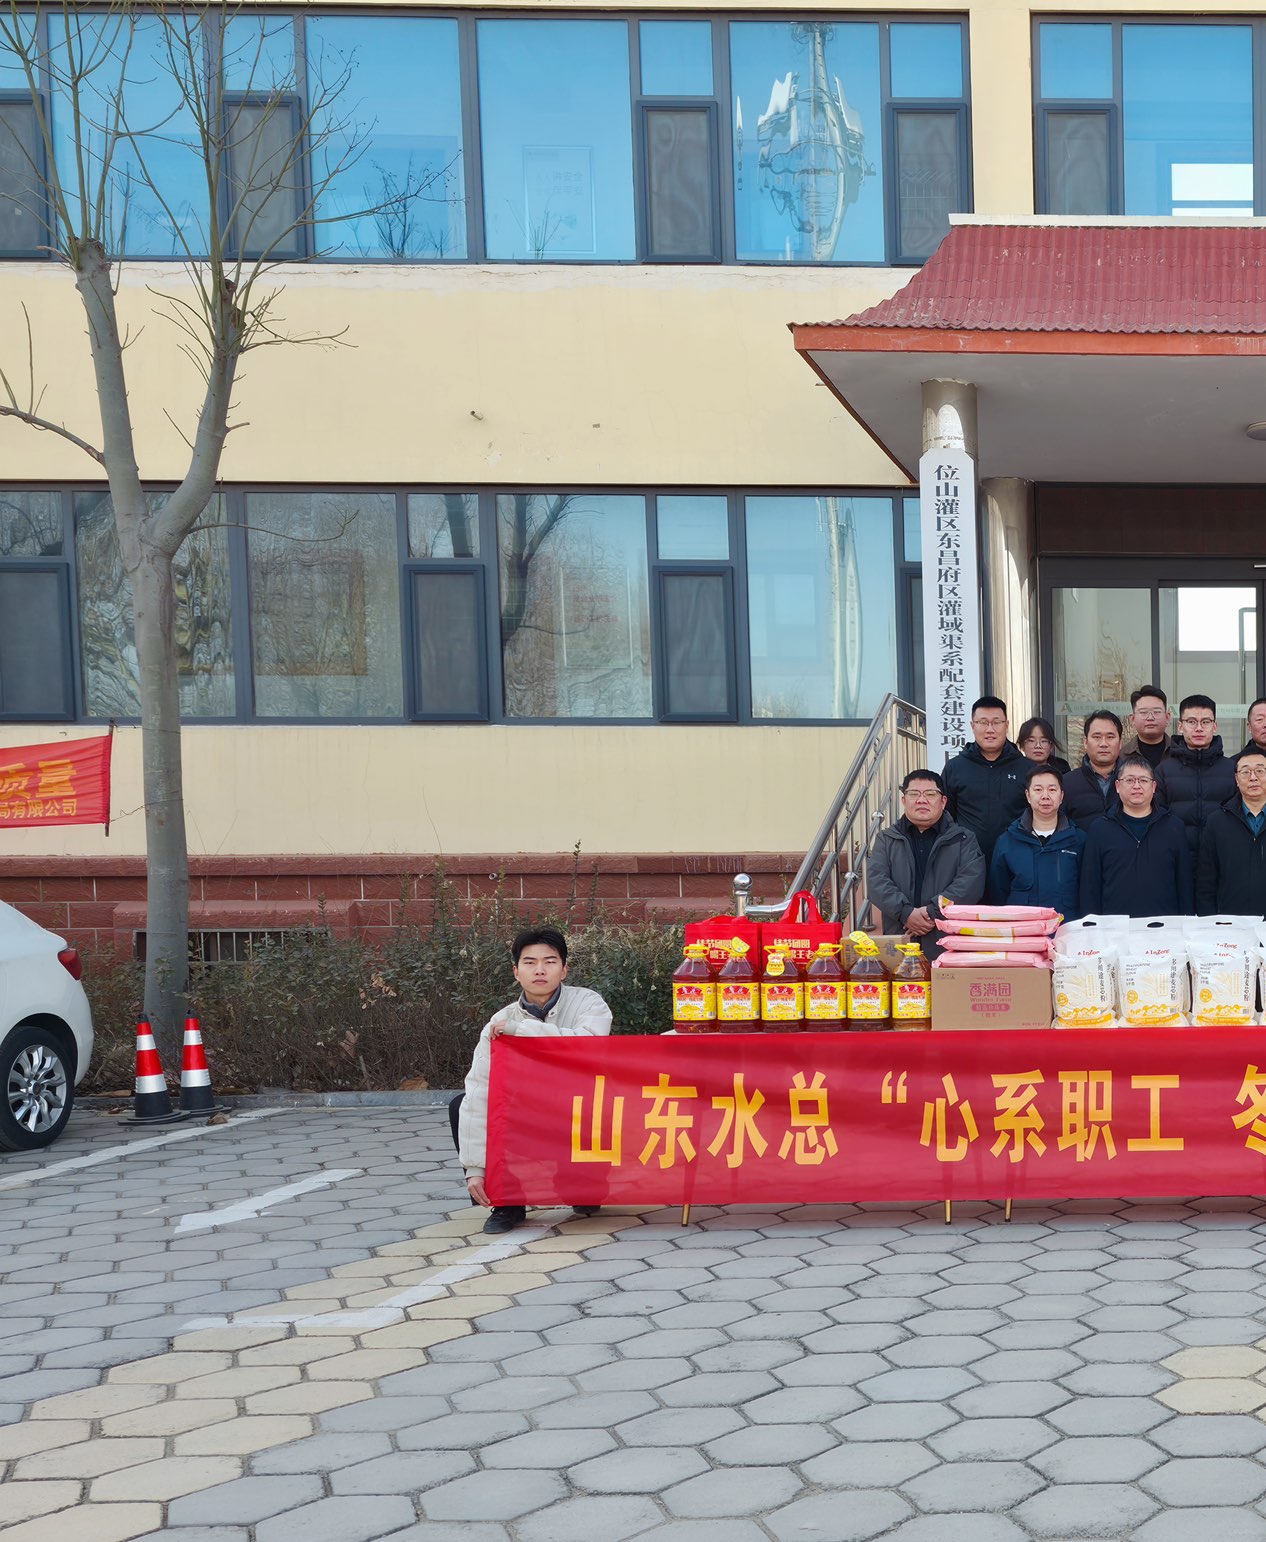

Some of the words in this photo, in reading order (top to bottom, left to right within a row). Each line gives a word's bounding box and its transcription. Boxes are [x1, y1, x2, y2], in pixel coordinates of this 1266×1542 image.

[0, 759, 77, 799] 质量
[0, 799, 77, 819] 局有限公司
[970, 983, 1011, 997] 香满园
[571, 1071, 839, 1169] 山东水总
[881, 1069, 1185, 1163] “心系职工
